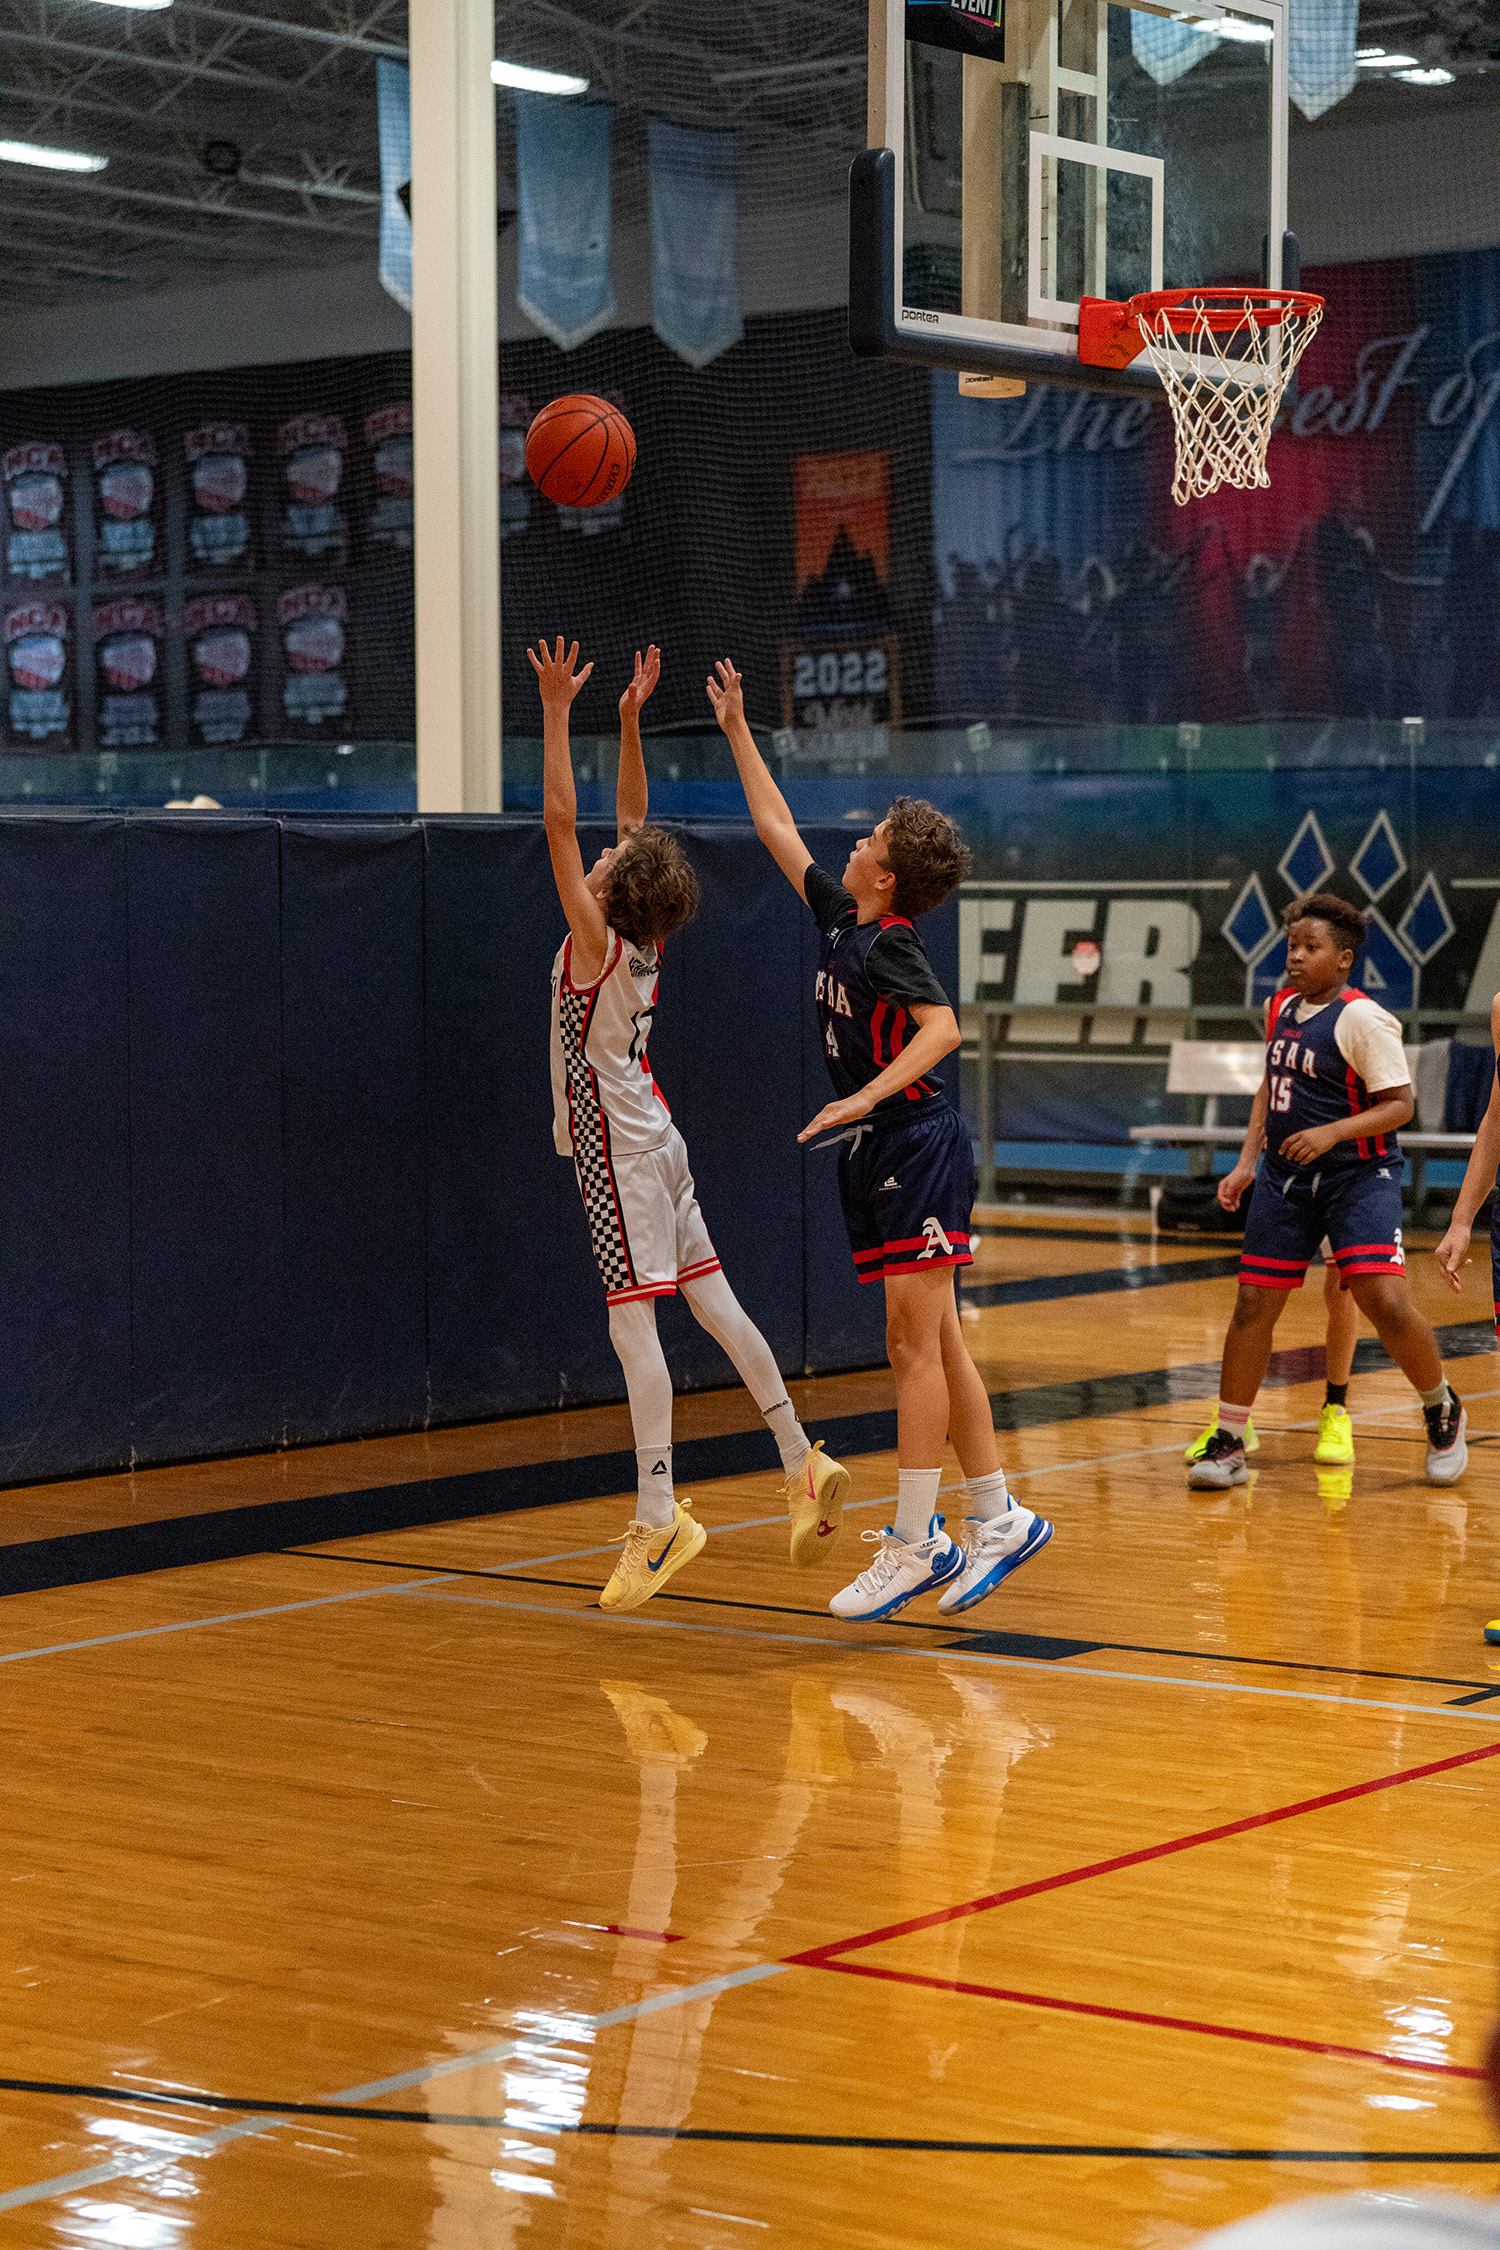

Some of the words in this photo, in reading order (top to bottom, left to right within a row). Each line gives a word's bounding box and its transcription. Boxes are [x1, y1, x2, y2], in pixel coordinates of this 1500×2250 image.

[794, 650, 887, 697] 2022
[1269, 1074, 1292, 1113] 15
[917, 1216, 954, 1261] A
